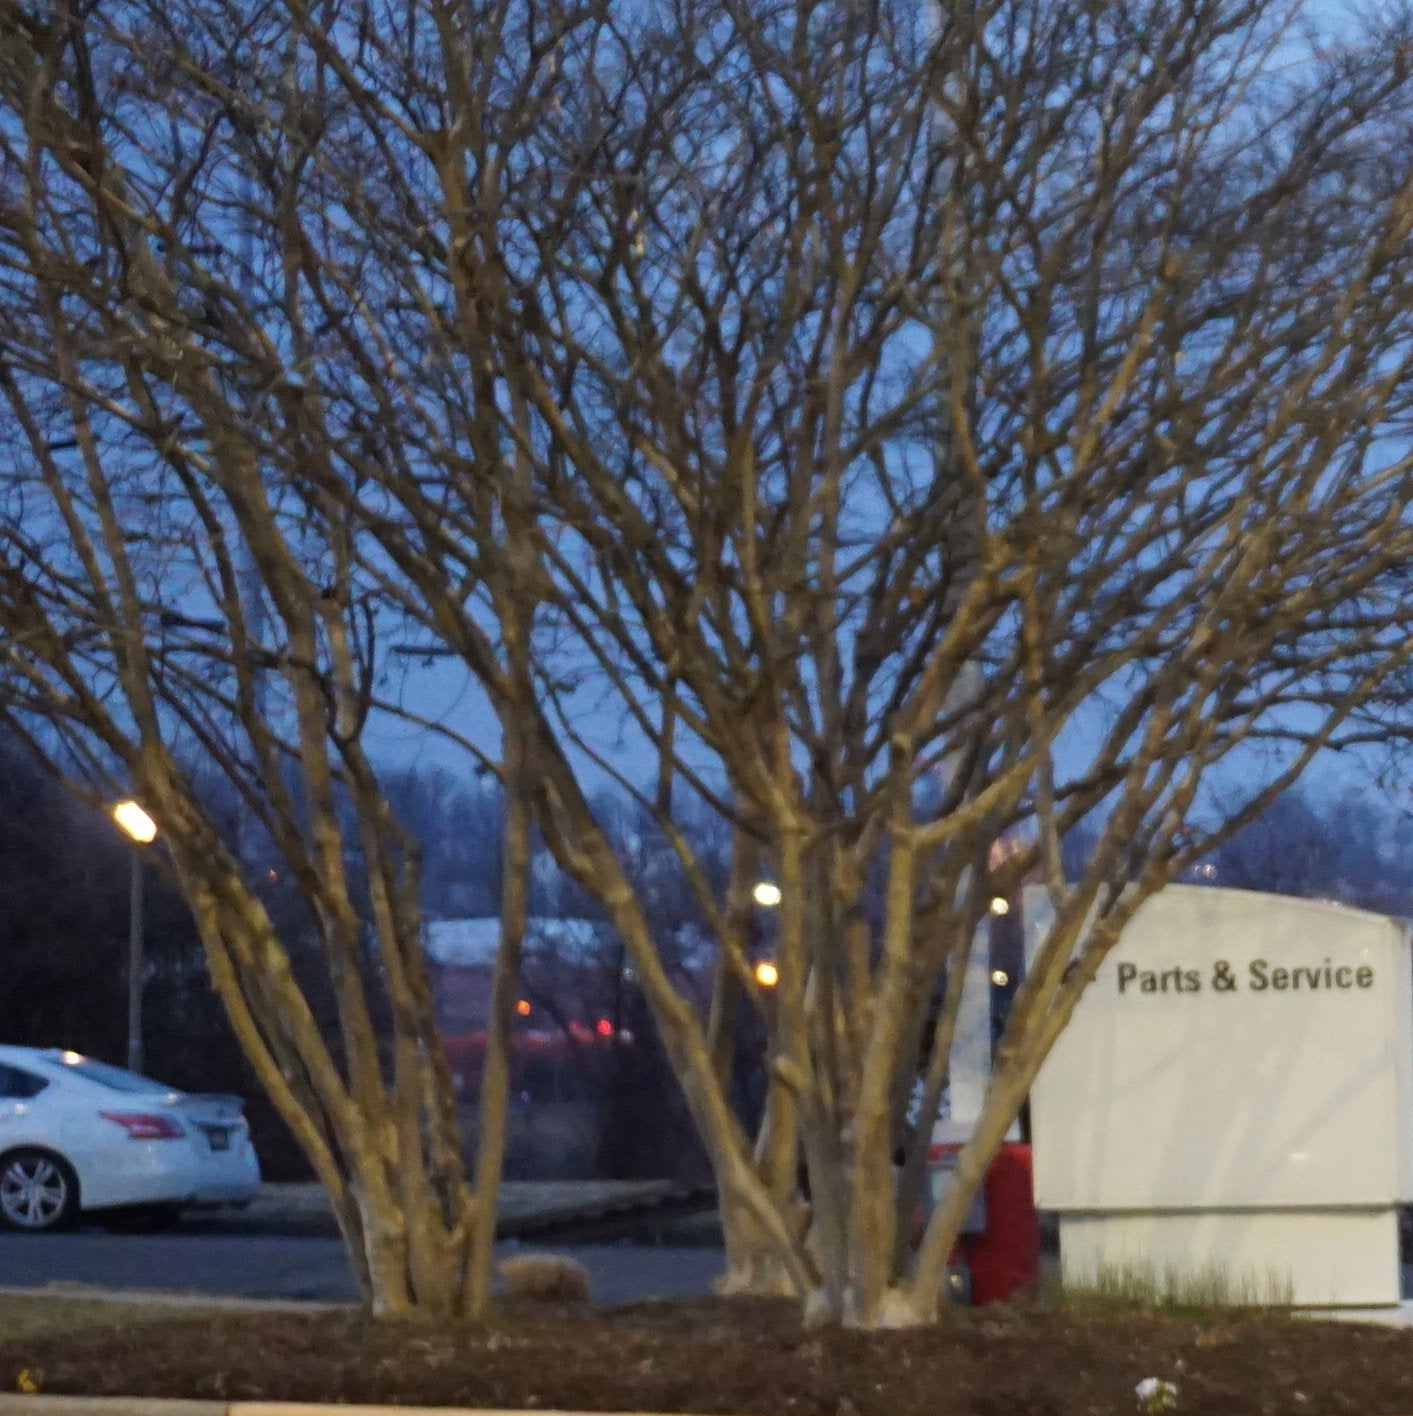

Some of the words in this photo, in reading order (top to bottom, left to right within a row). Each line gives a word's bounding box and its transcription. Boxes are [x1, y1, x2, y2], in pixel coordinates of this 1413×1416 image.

[1117, 961, 1201, 994] Parts
[1211, 959, 1237, 992] &
[1248, 957, 1374, 992] Service
